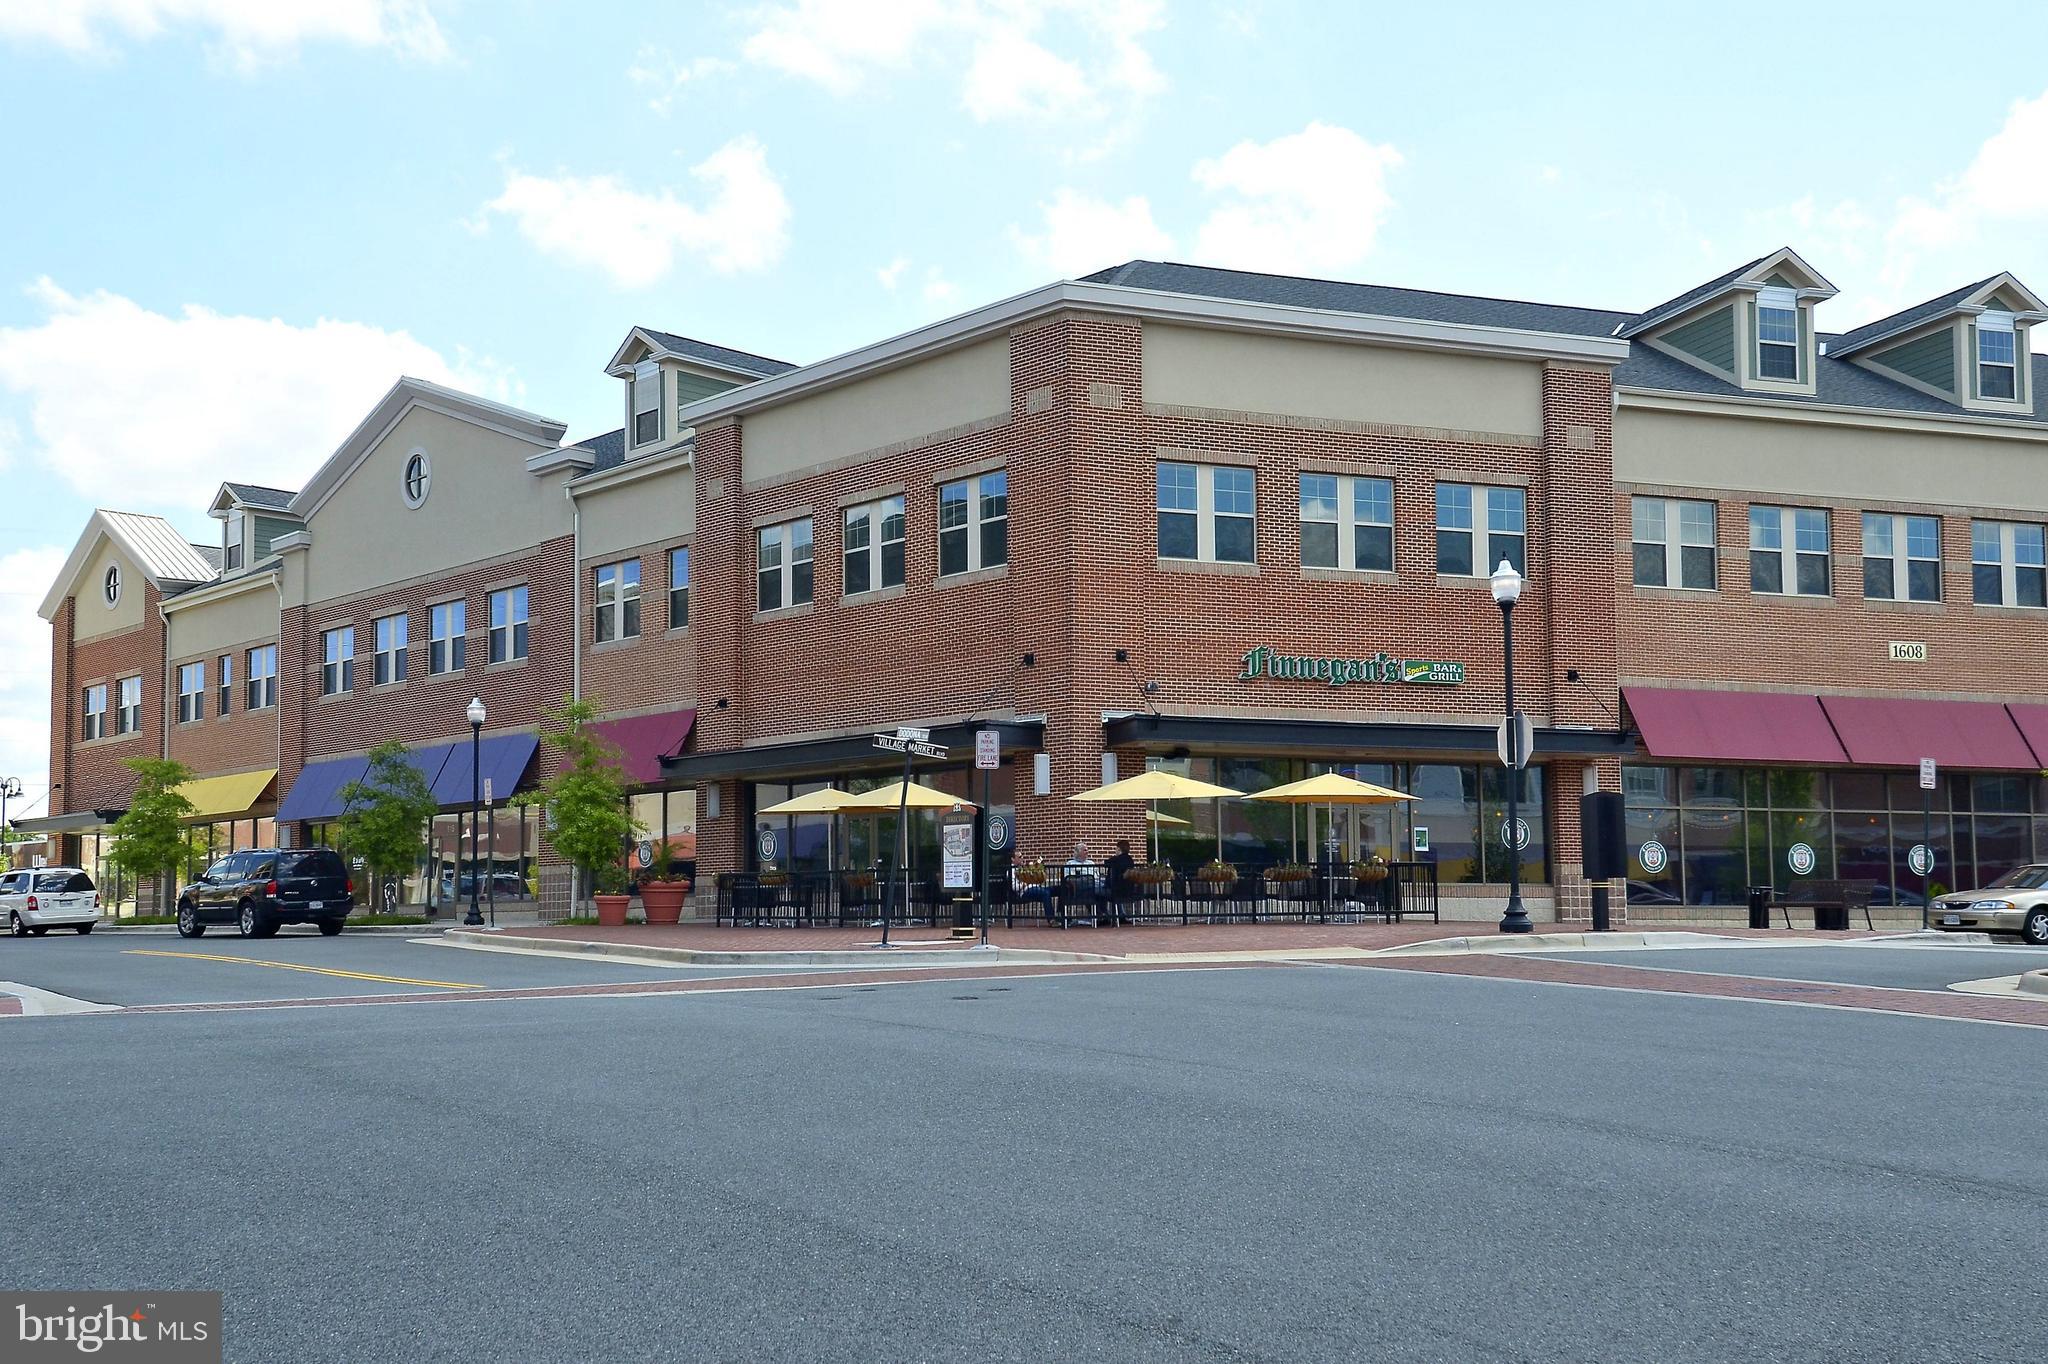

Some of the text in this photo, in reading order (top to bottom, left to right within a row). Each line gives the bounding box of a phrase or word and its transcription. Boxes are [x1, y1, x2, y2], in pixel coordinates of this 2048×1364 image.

[1893, 644, 1923, 659] 1608
[1238, 645, 1400, 686] Finnegan's
[1406, 664, 1429, 676] Sports
[1429, 672, 1462, 681] GRILL
[878, 737, 906, 750] VILLAGE
[907, 742, 935, 755] MARKET
